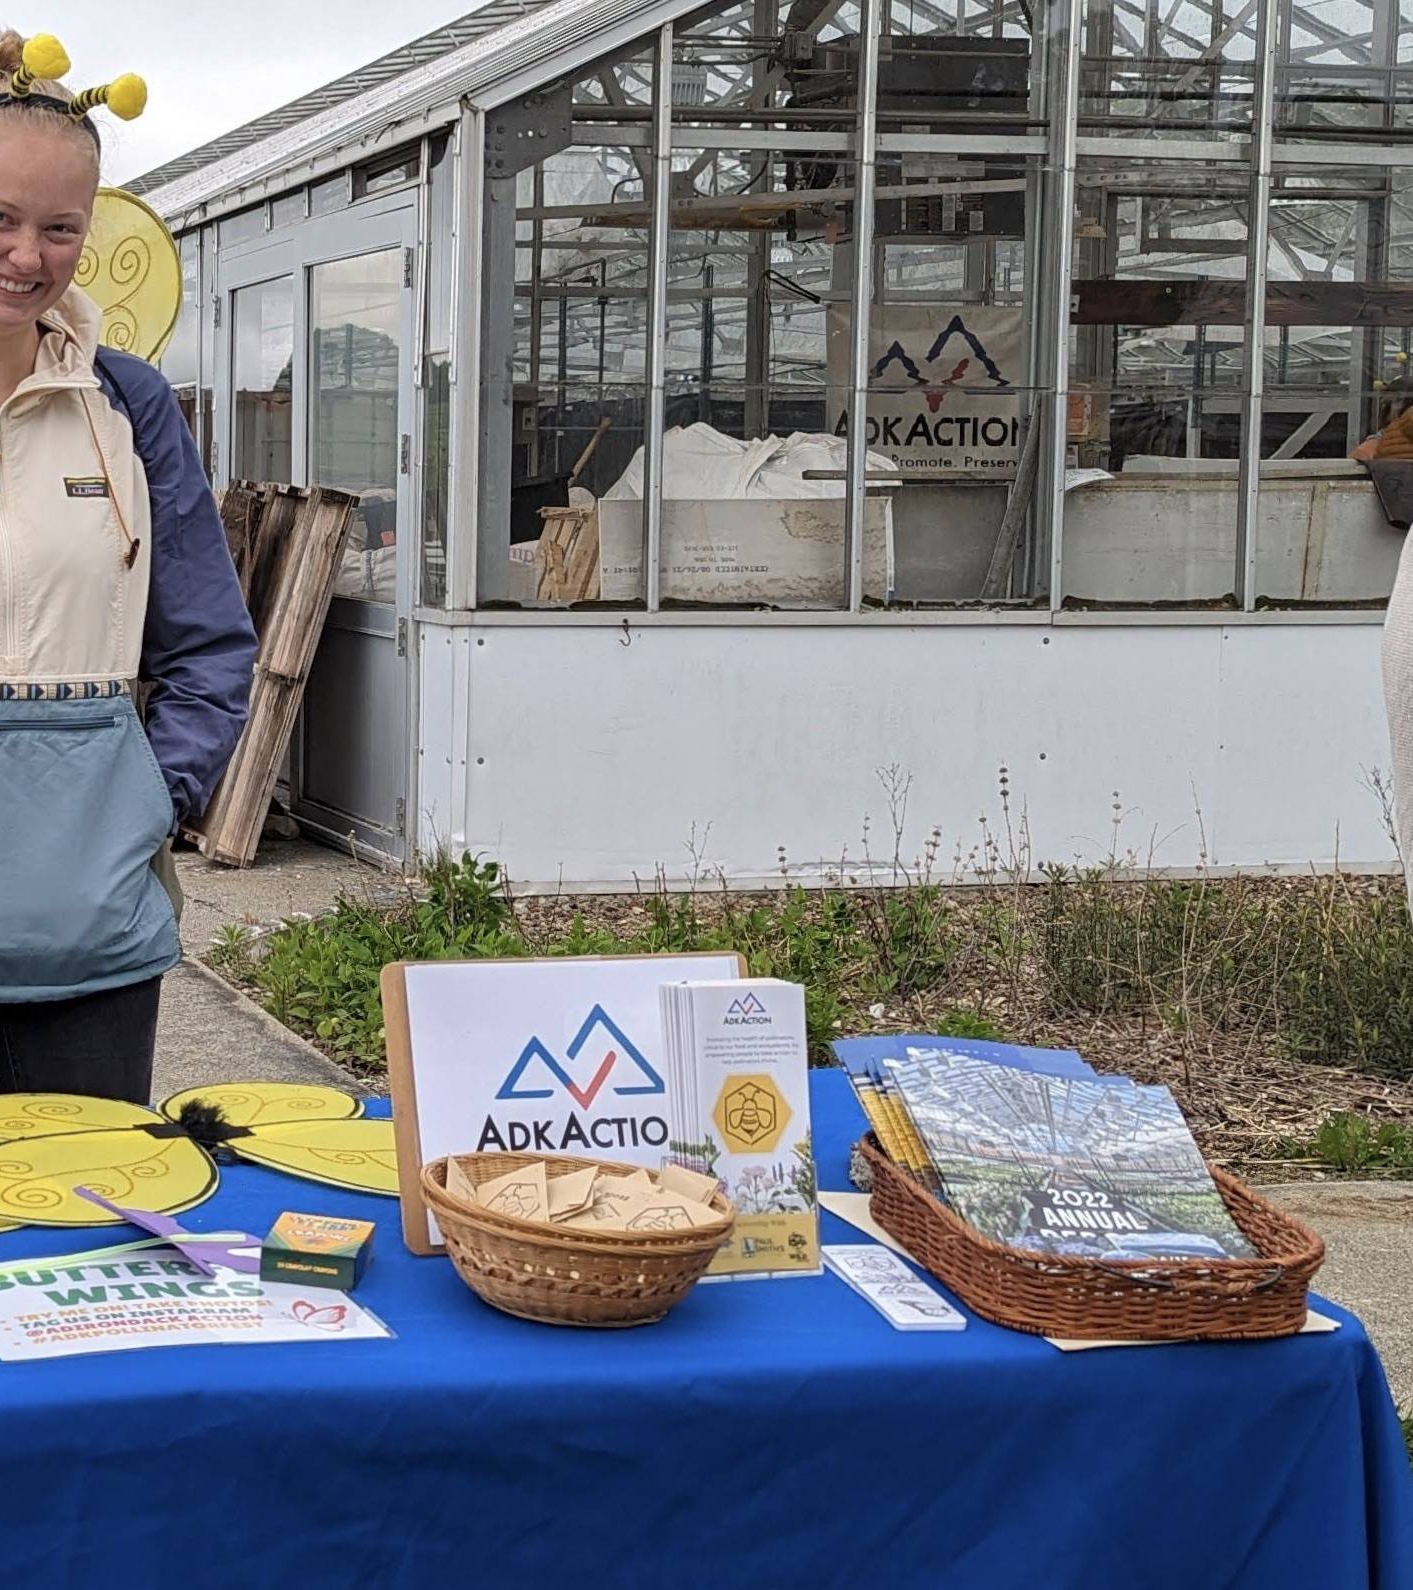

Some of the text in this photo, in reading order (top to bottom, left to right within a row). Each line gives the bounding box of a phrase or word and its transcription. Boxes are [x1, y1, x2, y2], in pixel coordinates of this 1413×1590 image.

[964, 456, 1017, 468] Preserv
[723, 1016, 772, 1025] ADKACTION
[476, 1111, 669, 1152] ADKACTIO
[1047, 1188, 1114, 1209] 2022
[1042, 1207, 1148, 1231] ANNUAL
[43, 1280, 265, 1306] WINGS
[14, 1299, 273, 1322] TRY ME ON! TAKE PHOTOS!
[18, 1307, 251, 1330] TAG US ON INSTAGRAM
[25, 1314, 265, 1338] @ADIRONDACK ACTION
